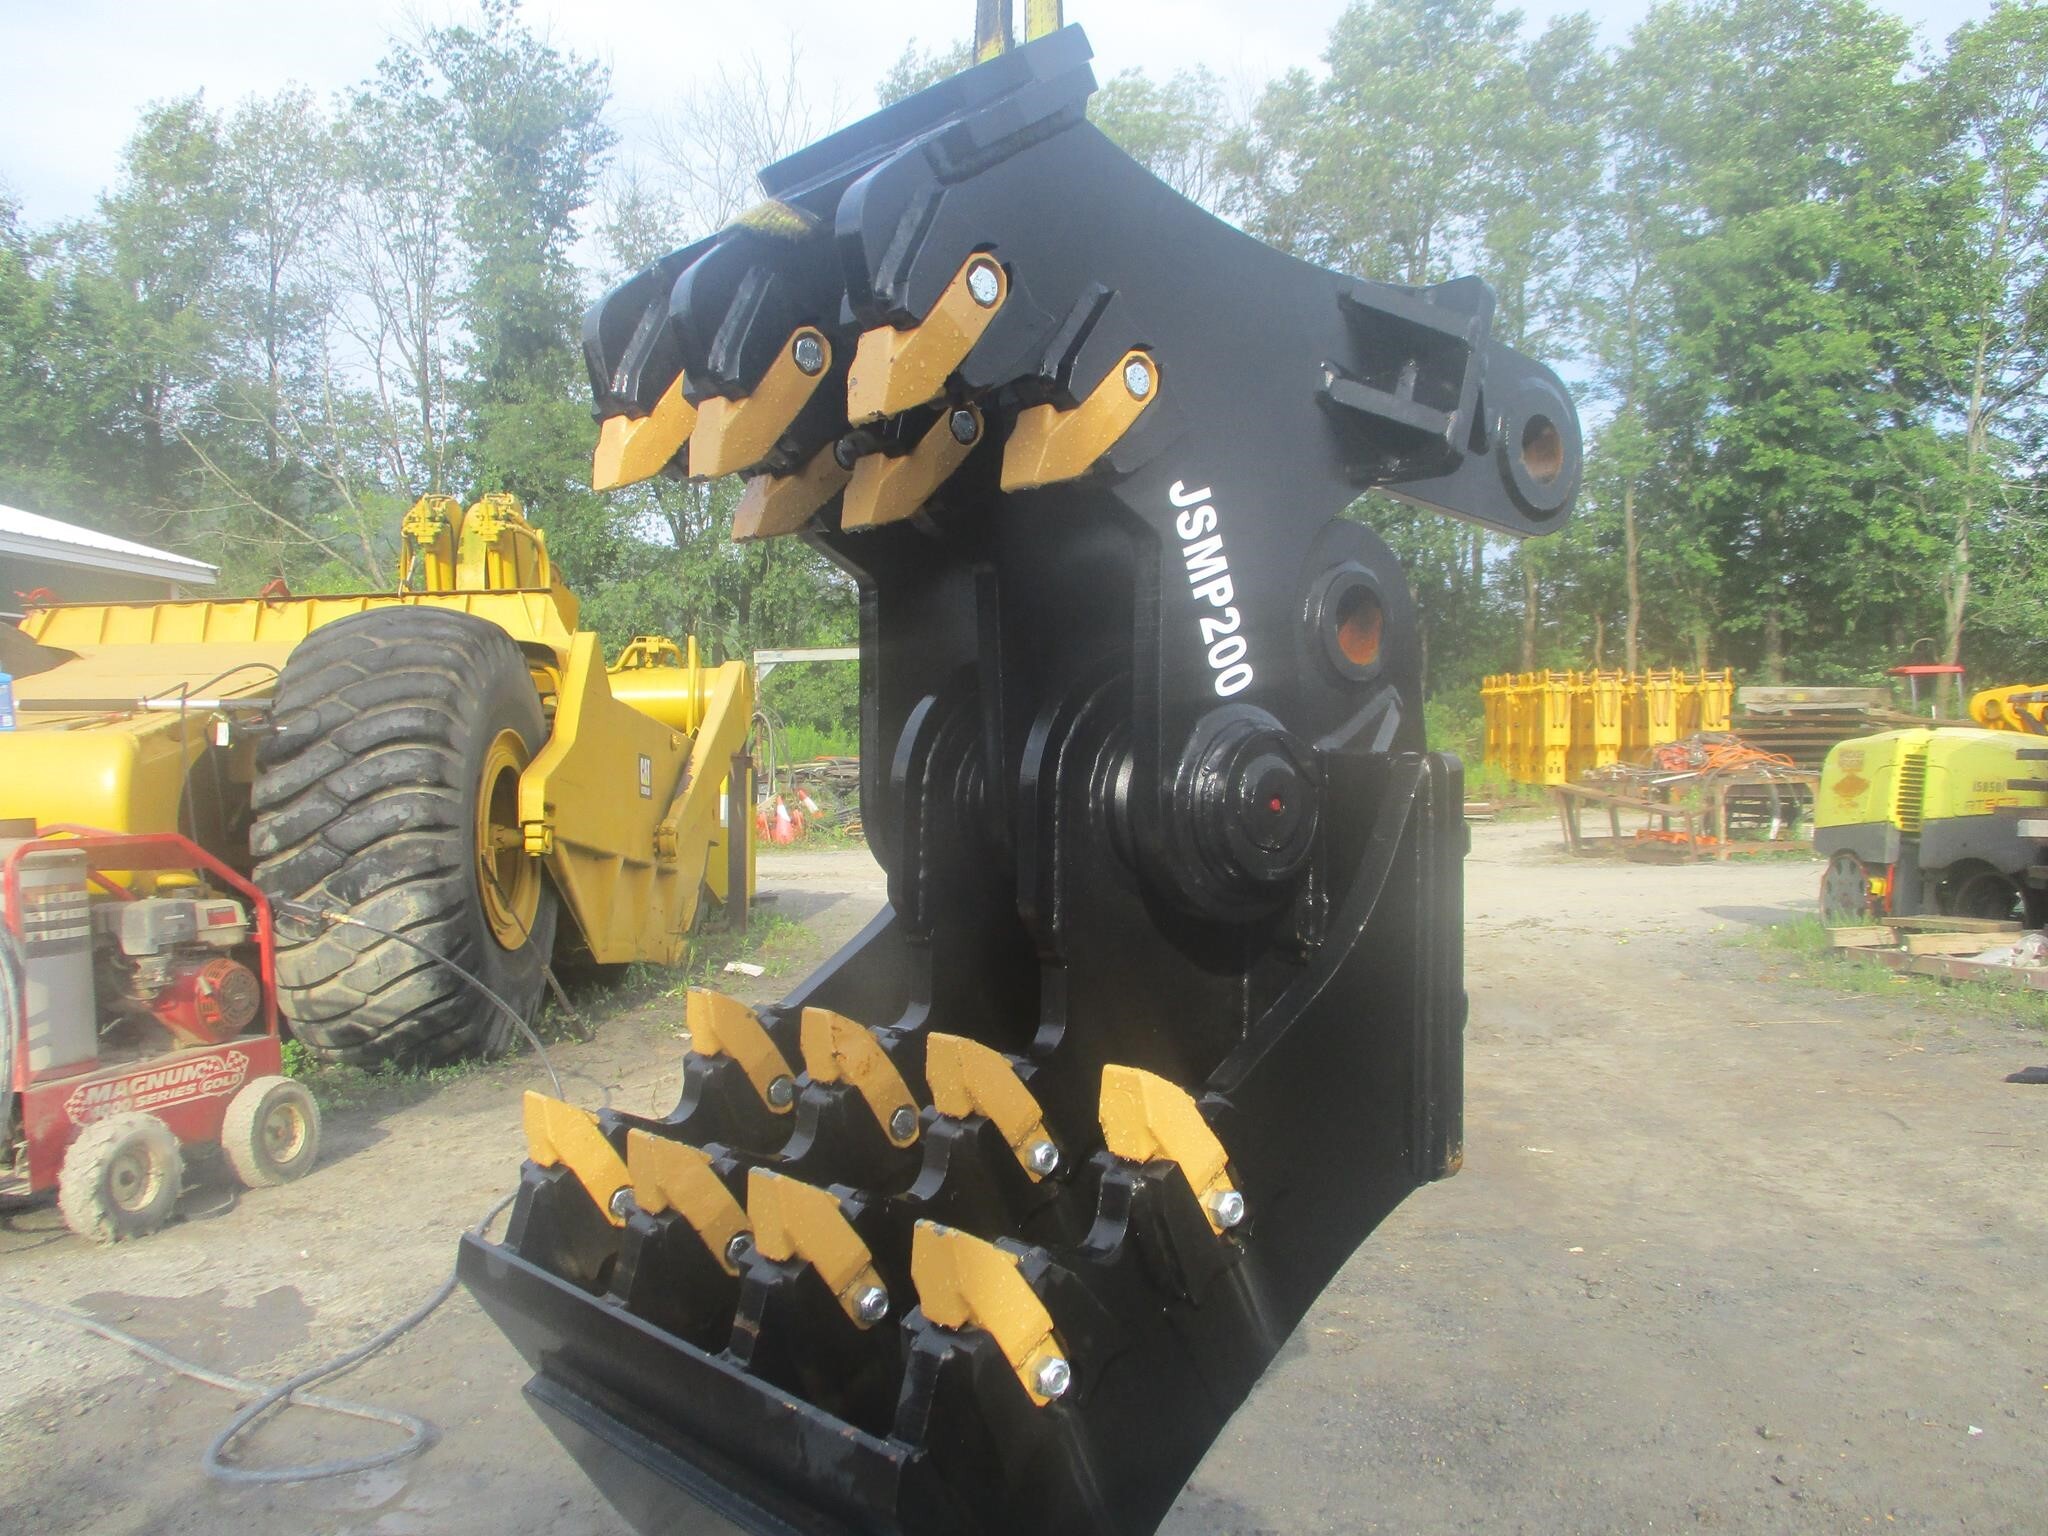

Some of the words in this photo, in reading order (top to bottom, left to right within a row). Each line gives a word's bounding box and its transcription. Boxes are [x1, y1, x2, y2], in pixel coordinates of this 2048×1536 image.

[1169, 480, 1254, 697] JSMP200
[640, 757, 651, 785] CAT
[84, 1063, 206, 1104] MAGNUM
[136, 1082, 197, 1106] SERIES
[201, 1074, 240, 1092] GOLD
